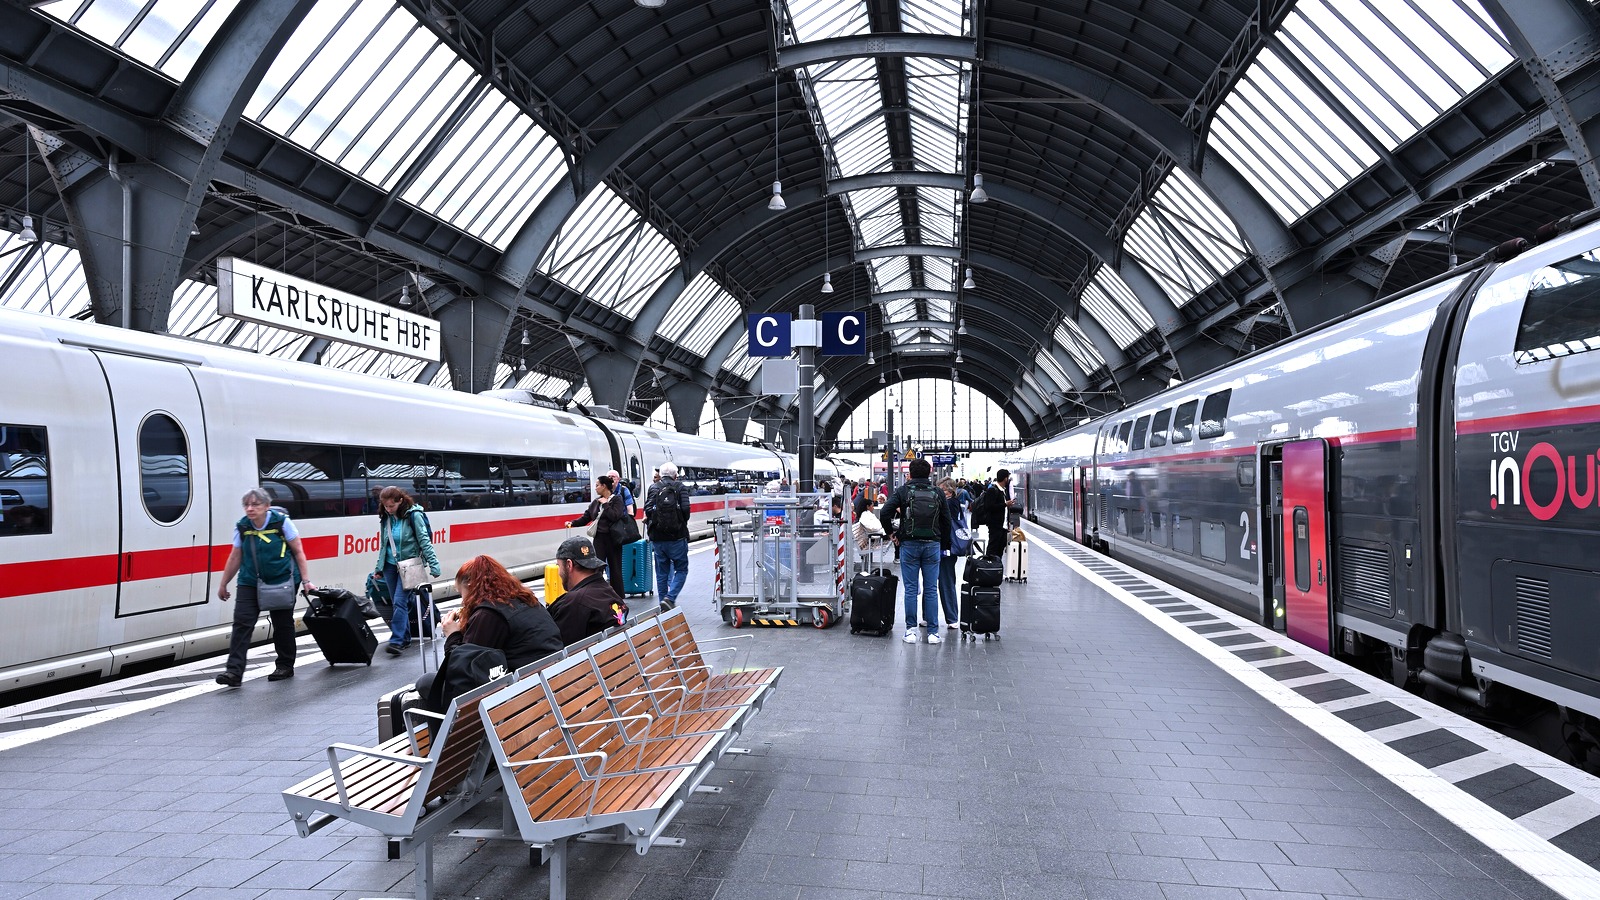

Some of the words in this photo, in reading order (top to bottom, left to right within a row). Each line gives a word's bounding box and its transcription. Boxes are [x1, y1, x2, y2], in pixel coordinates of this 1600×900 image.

[252, 274, 390, 342] KARLSRUHE
[397, 317, 430, 350] HBF
[756, 316, 778, 347] C
[838, 315, 859, 345] C
[1490, 431, 1519, 452] TGV
[1240, 511, 1250, 559] 2
